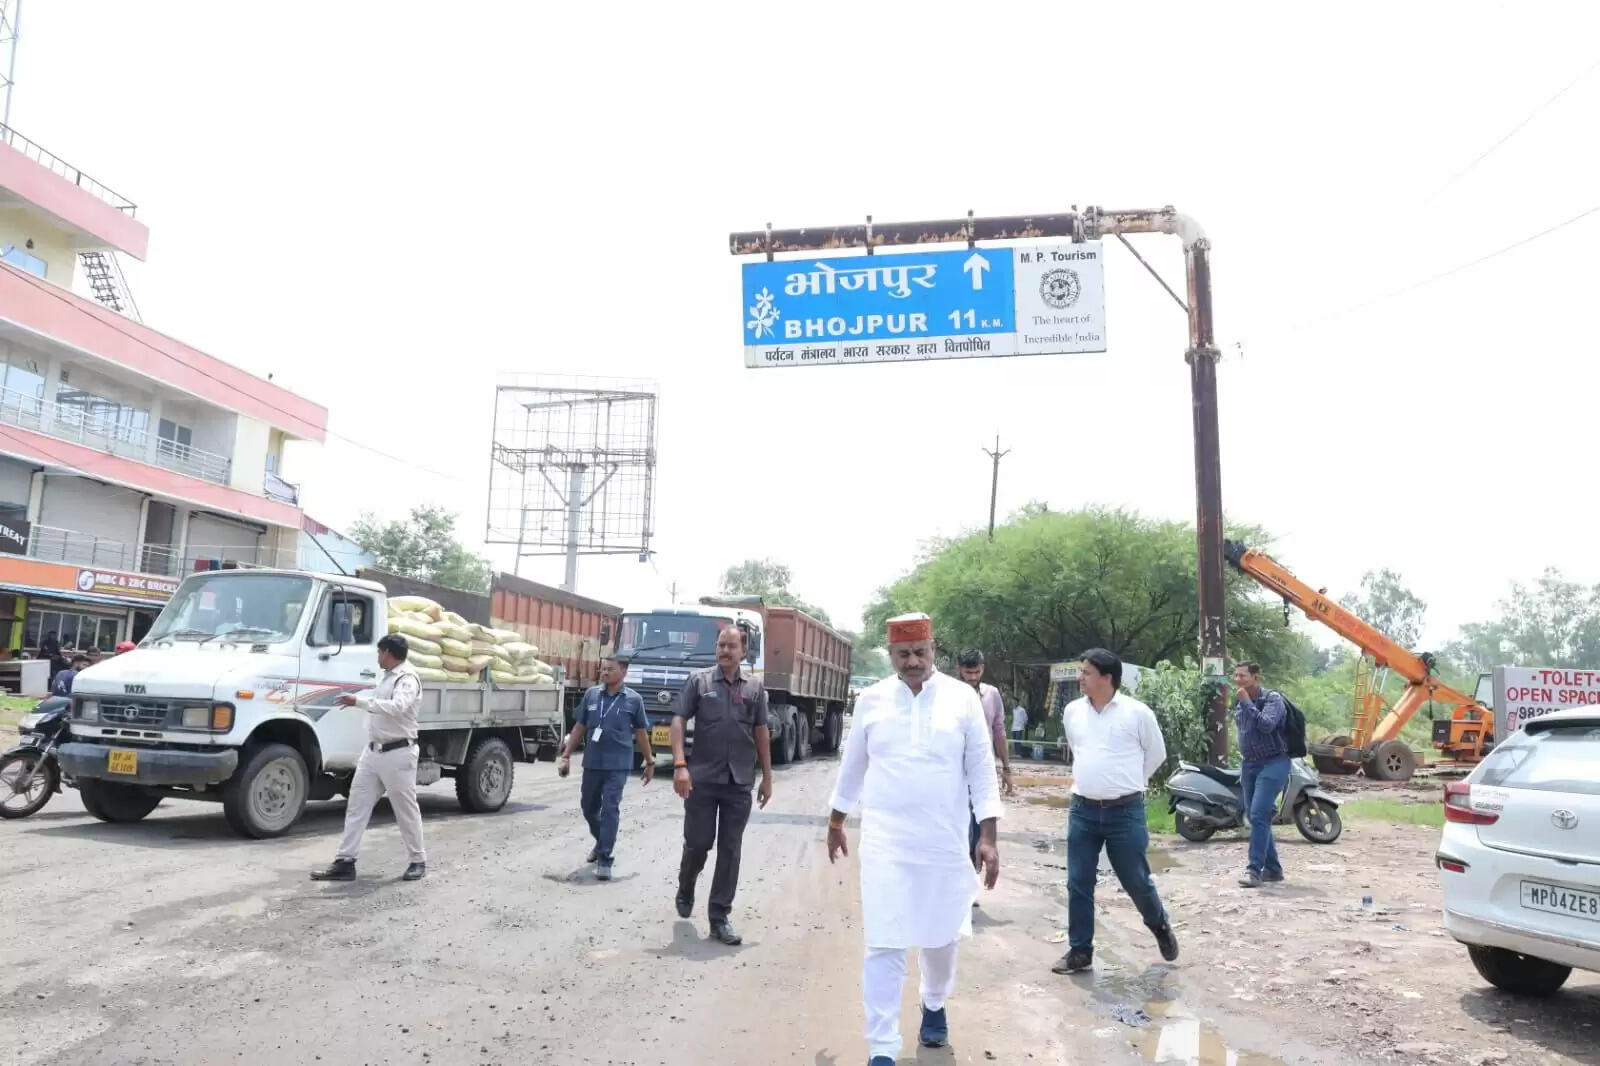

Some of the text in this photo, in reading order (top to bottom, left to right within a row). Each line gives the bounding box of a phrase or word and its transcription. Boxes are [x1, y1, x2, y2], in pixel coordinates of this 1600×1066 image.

[1036, 252, 1046, 263] P.
[1050, 250, 1097, 261] Tourism
[784, 261, 938, 299] भोजपुर
[784, 312, 929, 339] BHOJPUR
[947, 308, 976, 329] 11
[1032, 313, 1091, 326] The heart of
[1024, 333, 1073, 345] Incredible
[765, 346, 794, 361] पर्यटन
[801, 346, 836, 361] मंत्रालय
[843, 346, 869, 358] भारत
[876, 344, 910, 356] सरकार
[124, 684, 146, 694] TATA
[1507, 687, 1553, 702] OPEN
[1519, 706, 1561, 720] 982
[1531, 887, 1600, 915] MP04ZE8
